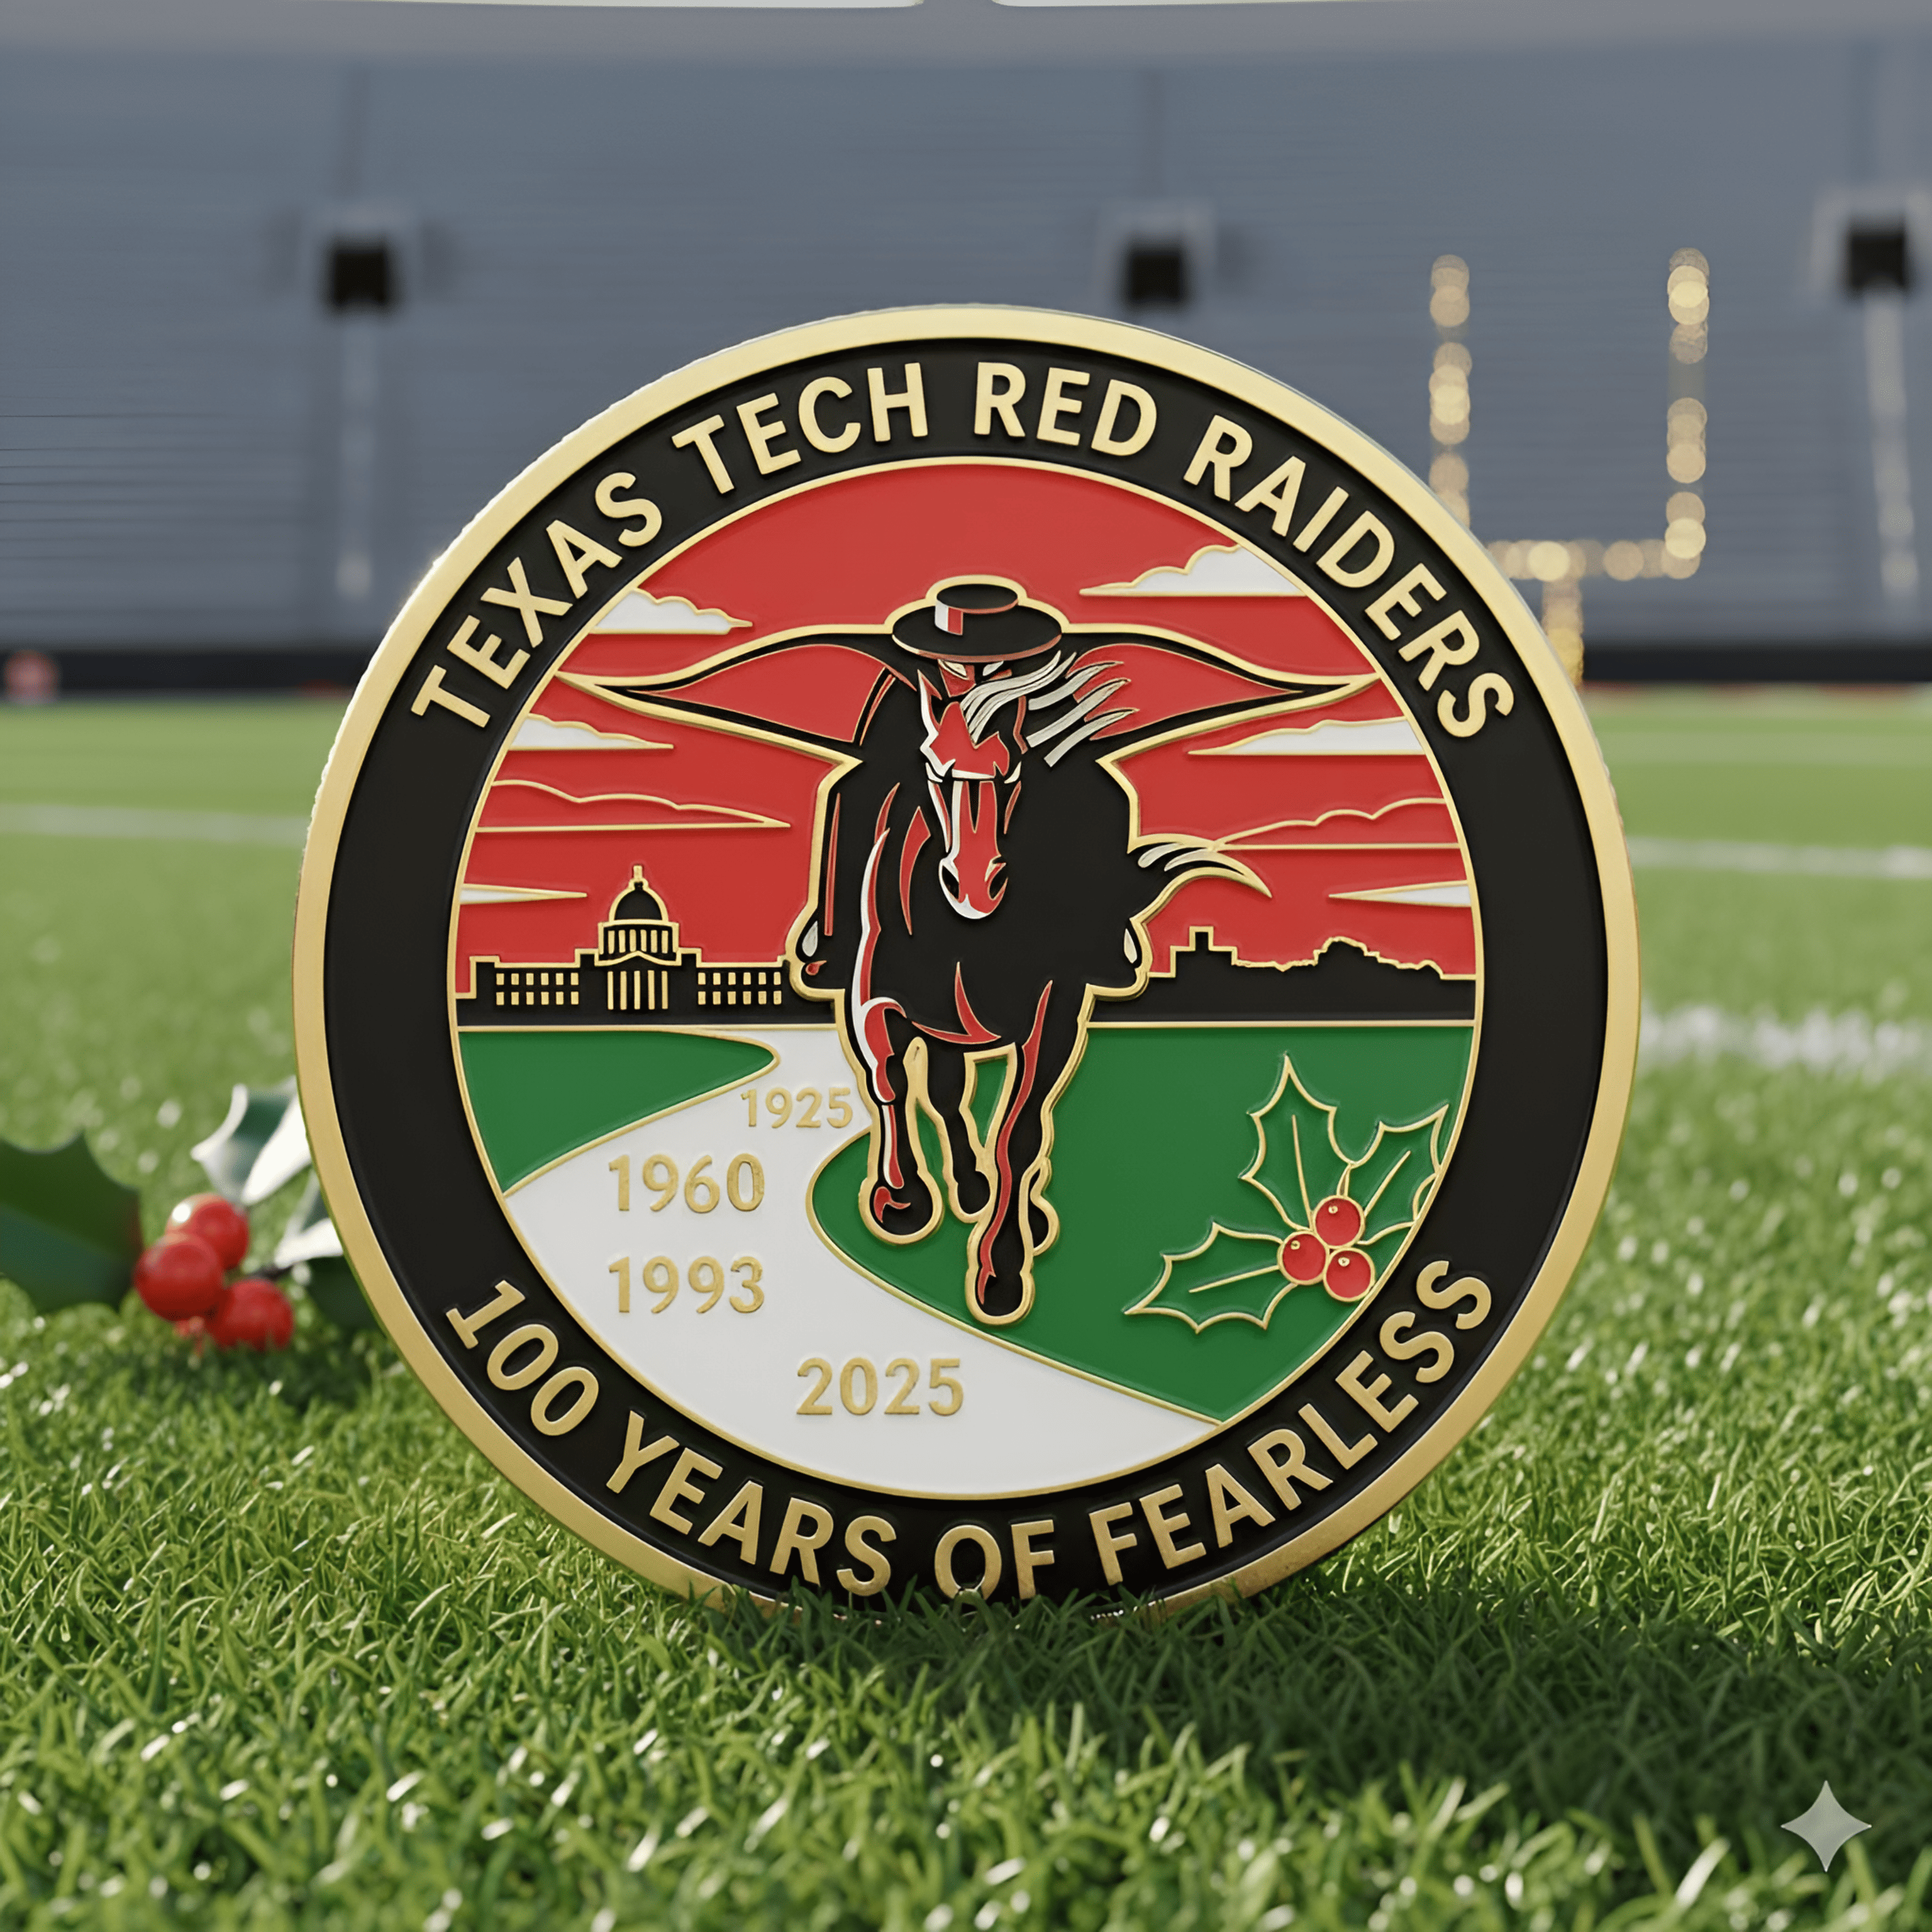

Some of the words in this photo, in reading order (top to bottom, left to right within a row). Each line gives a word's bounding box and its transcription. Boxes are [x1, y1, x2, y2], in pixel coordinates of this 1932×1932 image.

[411, 472, 662, 728] TEXAS
[671, 362, 928, 494] TECH
[974, 362, 1157, 457] RED
[1183, 414, 1514, 738] RAIDERS
[741, 1088, 853, 1128] 1925
[609, 1153, 765, 1213] 1960
[609, 1256, 765, 1313] 1993
[797, 1357, 963, 1416] 2025
[445, 1279, 599, 1436] 100
[606, 1410, 897, 1596] YEARS
[934, 1524, 1055, 1599] OF
[1089, 1260, 1492, 1585] FEARLESS
